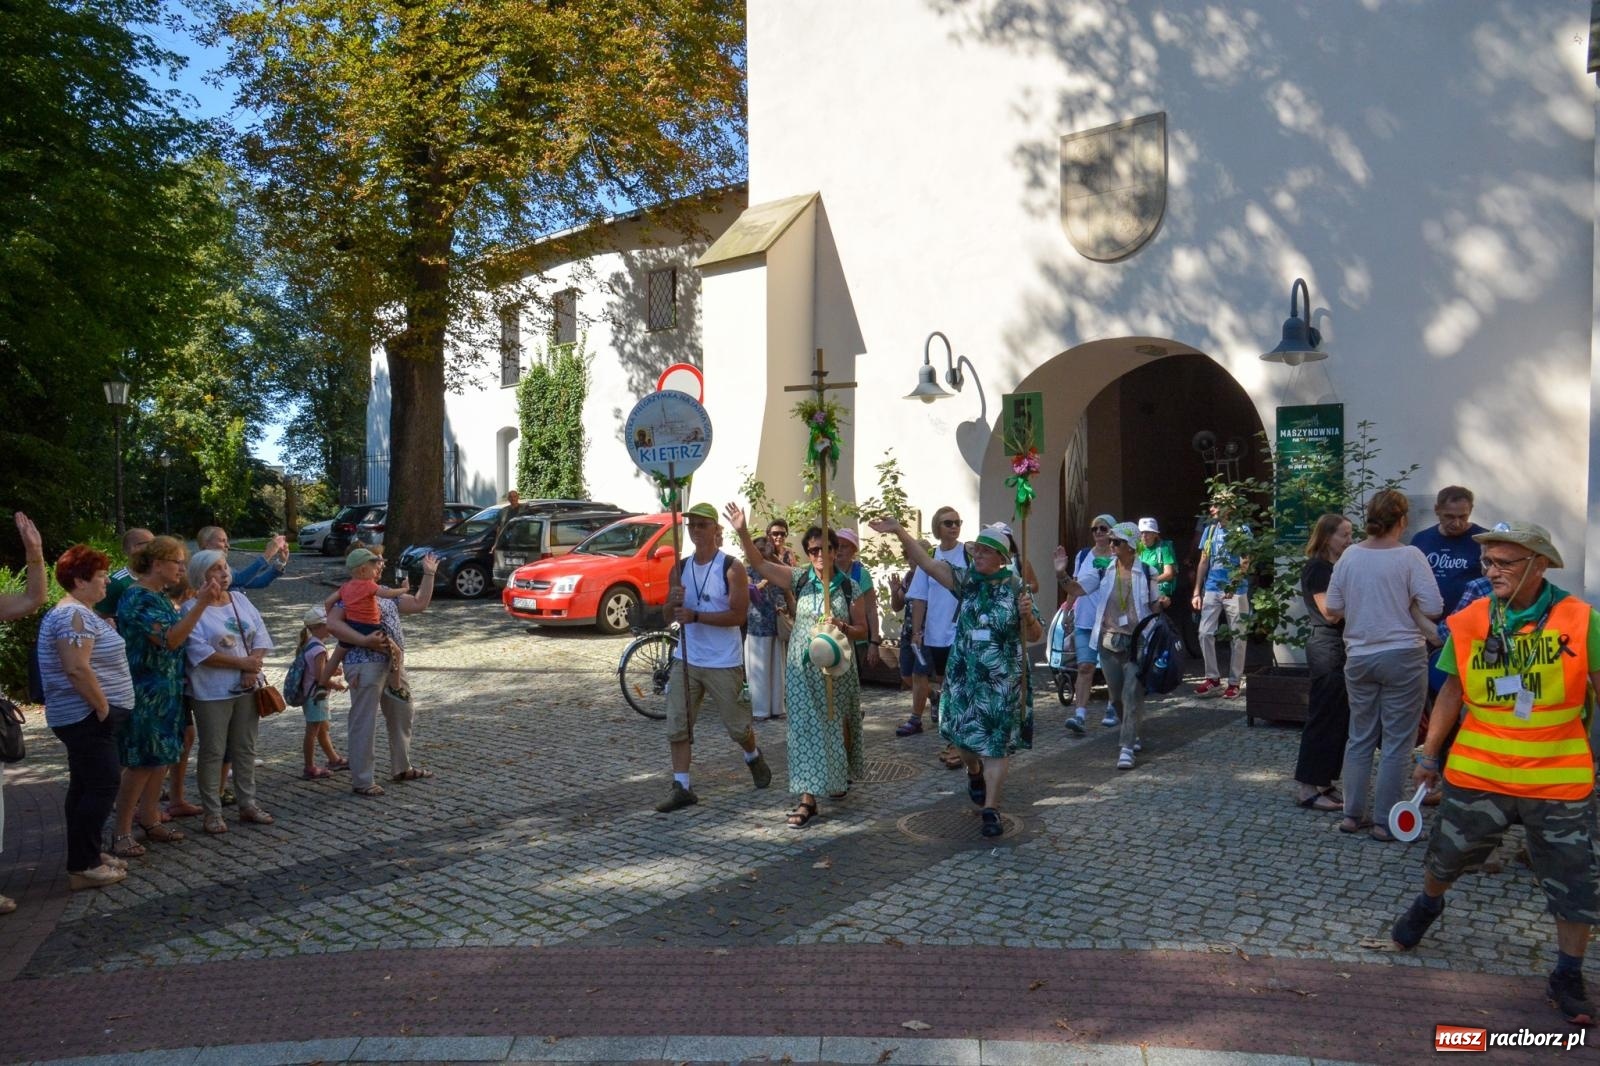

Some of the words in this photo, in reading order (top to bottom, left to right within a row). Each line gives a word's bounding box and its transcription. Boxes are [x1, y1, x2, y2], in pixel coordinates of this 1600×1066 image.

[1280, 427, 1340, 438] MASZYNOWNIA
[640, 444, 702, 462] KIETRZ
[1427, 552, 1468, 569] Oliver
